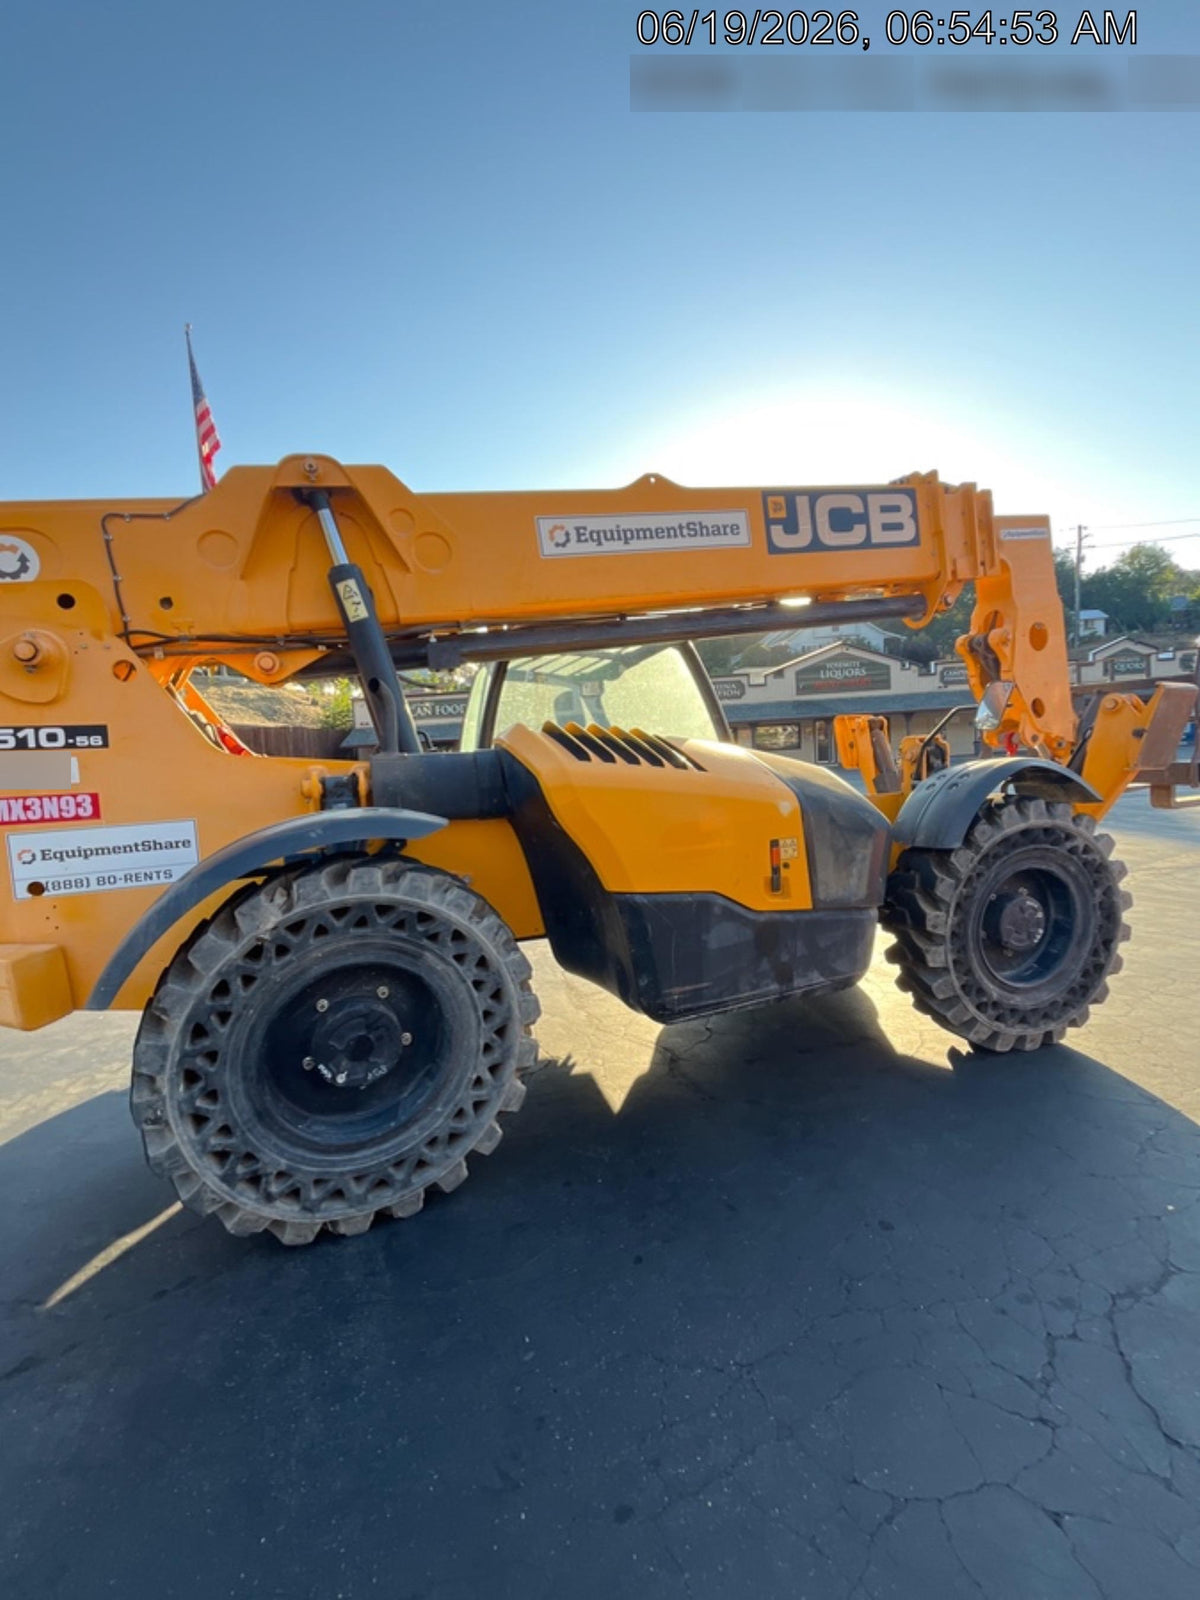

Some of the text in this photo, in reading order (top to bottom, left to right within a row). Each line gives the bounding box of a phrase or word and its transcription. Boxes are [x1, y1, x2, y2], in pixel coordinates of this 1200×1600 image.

[770, 493, 917, 548] JCB
[574, 521, 741, 545] EquipmentShare
[820, 667, 866, 680] LIQUORS
[40, 838, 191, 863] EquipmentShare
[44, 876, 91, 893] (888)
